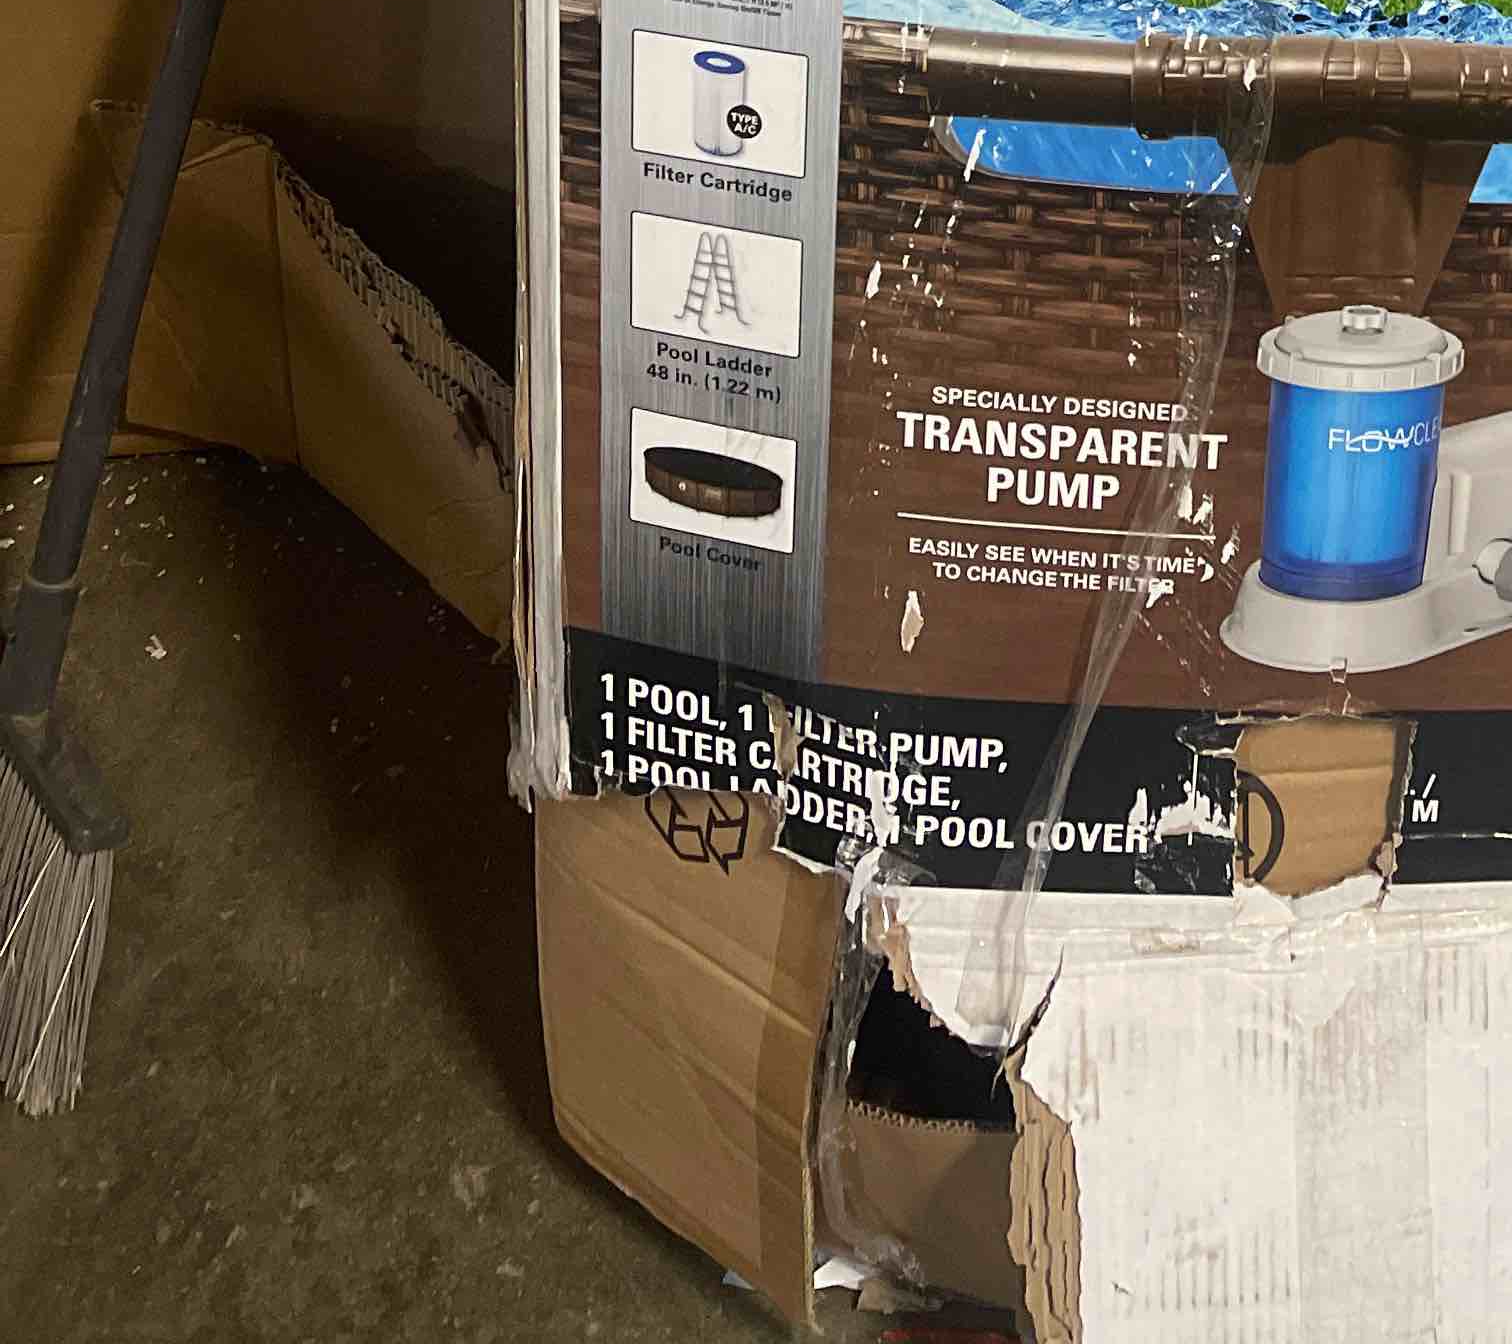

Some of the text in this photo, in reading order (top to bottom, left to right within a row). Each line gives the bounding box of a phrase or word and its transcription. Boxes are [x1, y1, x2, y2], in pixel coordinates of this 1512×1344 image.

[731, 111, 758, 126] TYPE
[734, 122, 757, 135] A/C
[643, 161, 793, 203] Filter Cartridge
[657, 341, 773, 379] Pool Ladder
[646, 363, 669, 381] 48
[675, 367, 698, 387] in.
[756, 384, 782, 405] m)
[930, 385, 1188, 423] SPECIALLY DESIGNED
[895, 410, 1230, 471] TRANSPARENT
[986, 465, 1121, 511] PUMP
[660, 535, 763, 572] Pool Cover
[907, 536, 1197, 575] EASILY SEE WHEN IT'S TIME
[932, 560, 962, 582] TO
[965, 564, 1059, 589] CHANGE
[1060, 570, 1102, 592] THE
[600, 672, 614, 703] 1
[627, 677, 728, 732] POOL,
[737, 703, 753, 732] 1
[889, 731, 1008, 774] PUMP,
[600, 711, 614, 741] 1
[627, 715, 738, 767] FILTER
[600, 749, 614, 777] 1
[914, 815, 1015, 850] POOL
[1025, 819, 1149, 855] COVER
